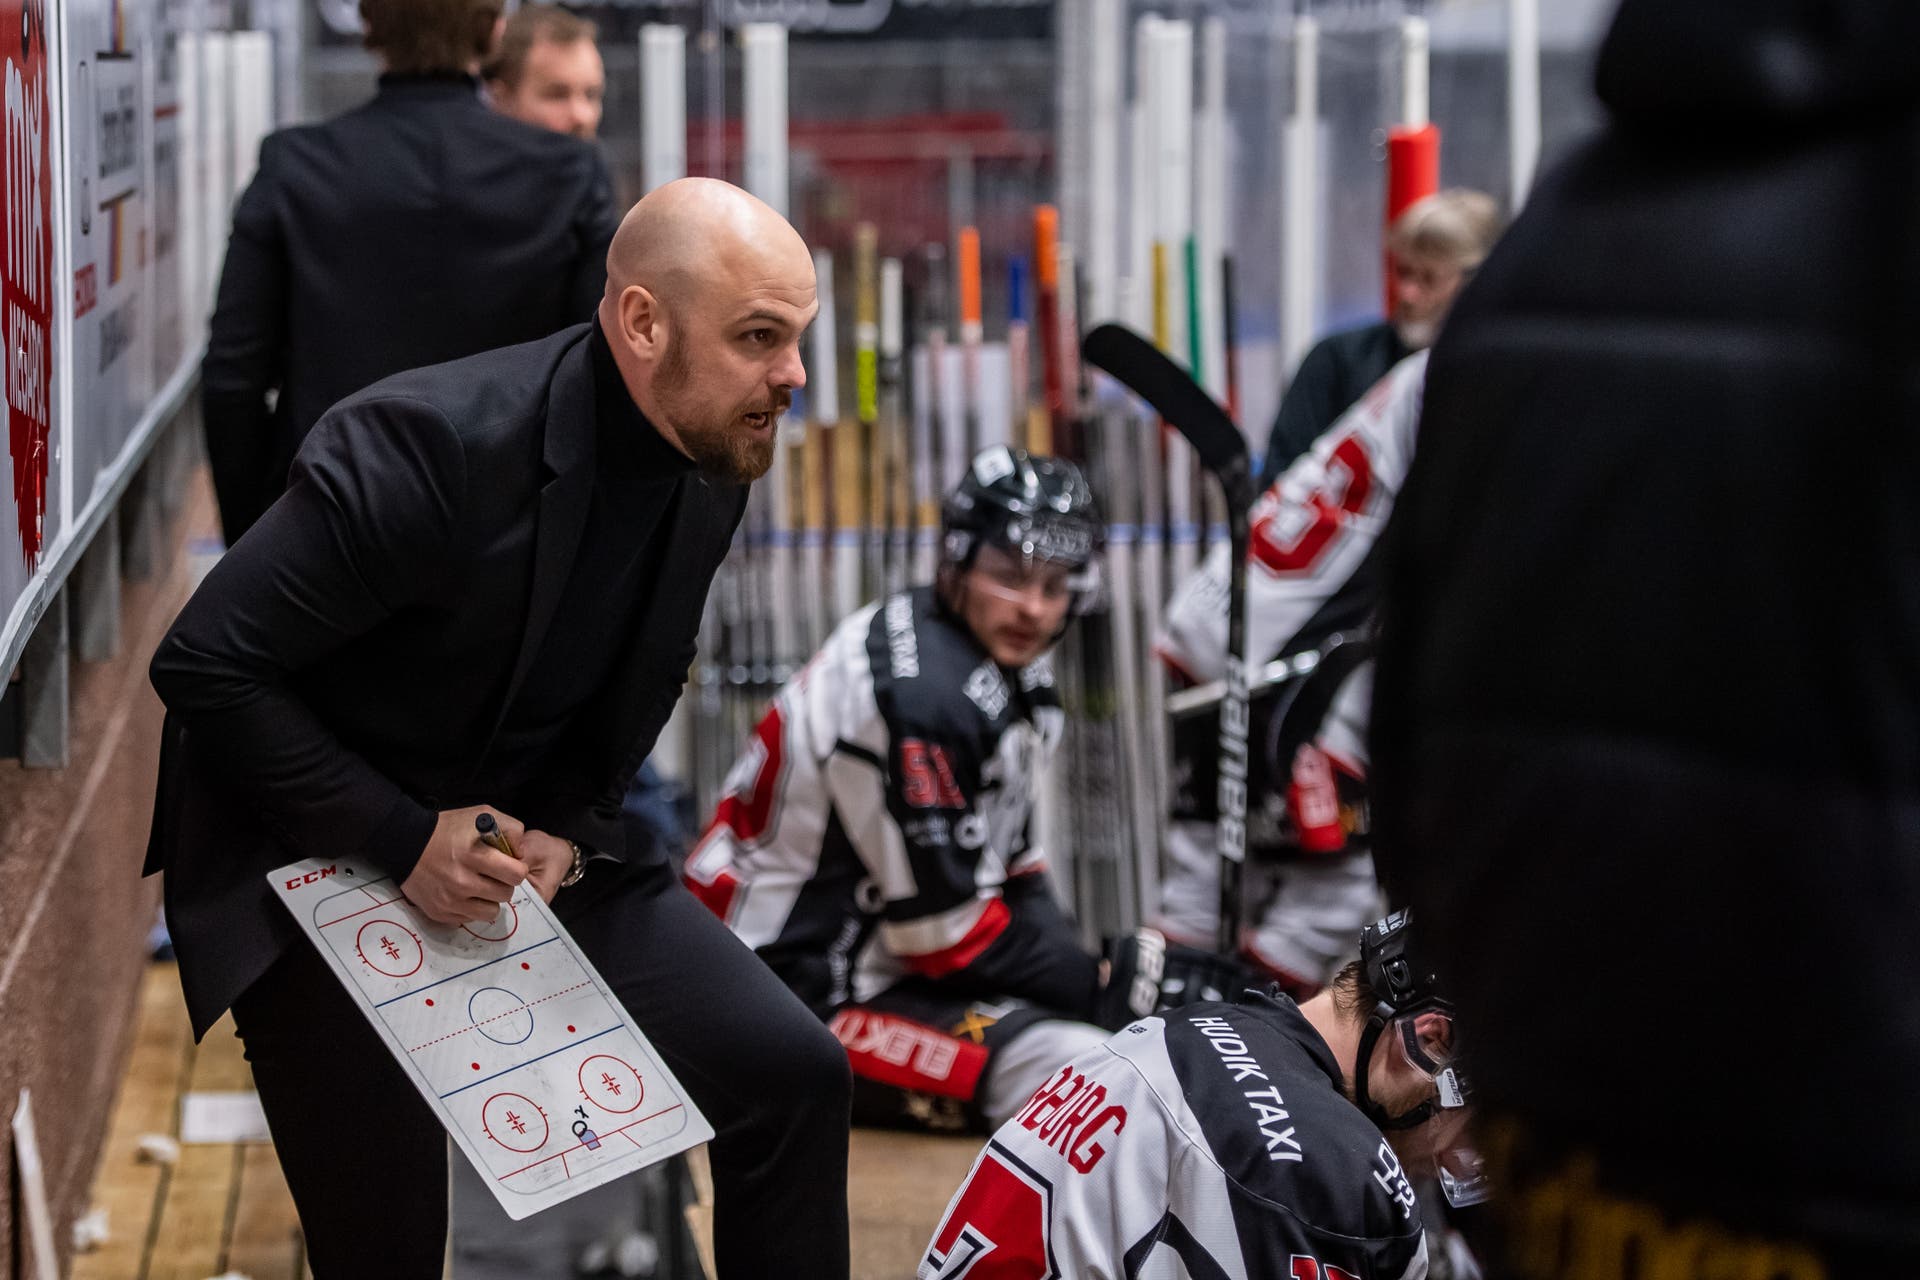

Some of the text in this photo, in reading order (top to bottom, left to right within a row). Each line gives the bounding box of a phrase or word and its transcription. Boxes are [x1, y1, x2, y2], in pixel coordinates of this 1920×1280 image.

[5, 57, 46, 314] mix
[9, 299, 47, 427] MEGAPOL
[284, 864, 337, 890] CCM
[1188, 1016, 1304, 1163] HUDIK TAXI
